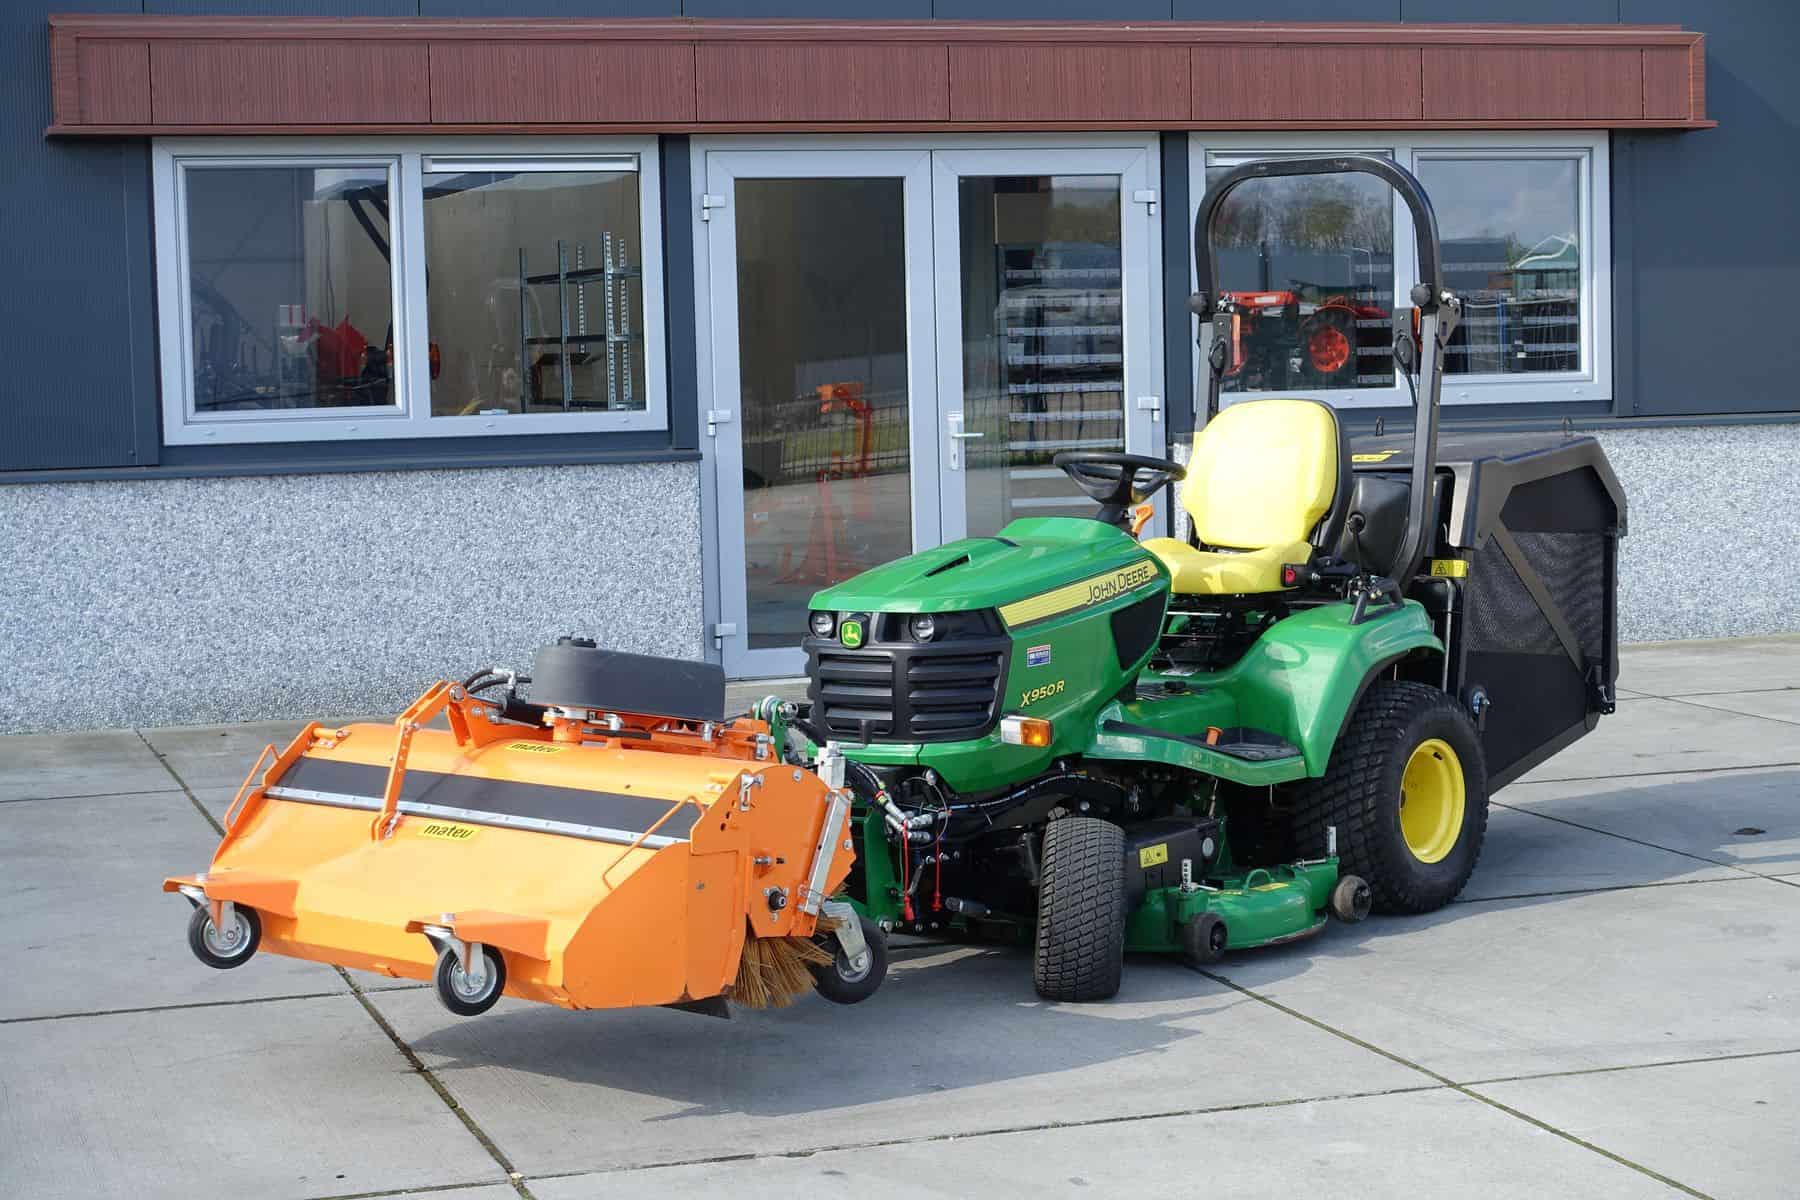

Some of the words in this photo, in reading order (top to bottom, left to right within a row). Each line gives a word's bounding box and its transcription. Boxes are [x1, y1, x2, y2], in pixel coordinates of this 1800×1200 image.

[1086, 579, 1118, 603] JOHN
[1117, 565, 1149, 590] DEERE
[1020, 680, 1065, 708] X950R
